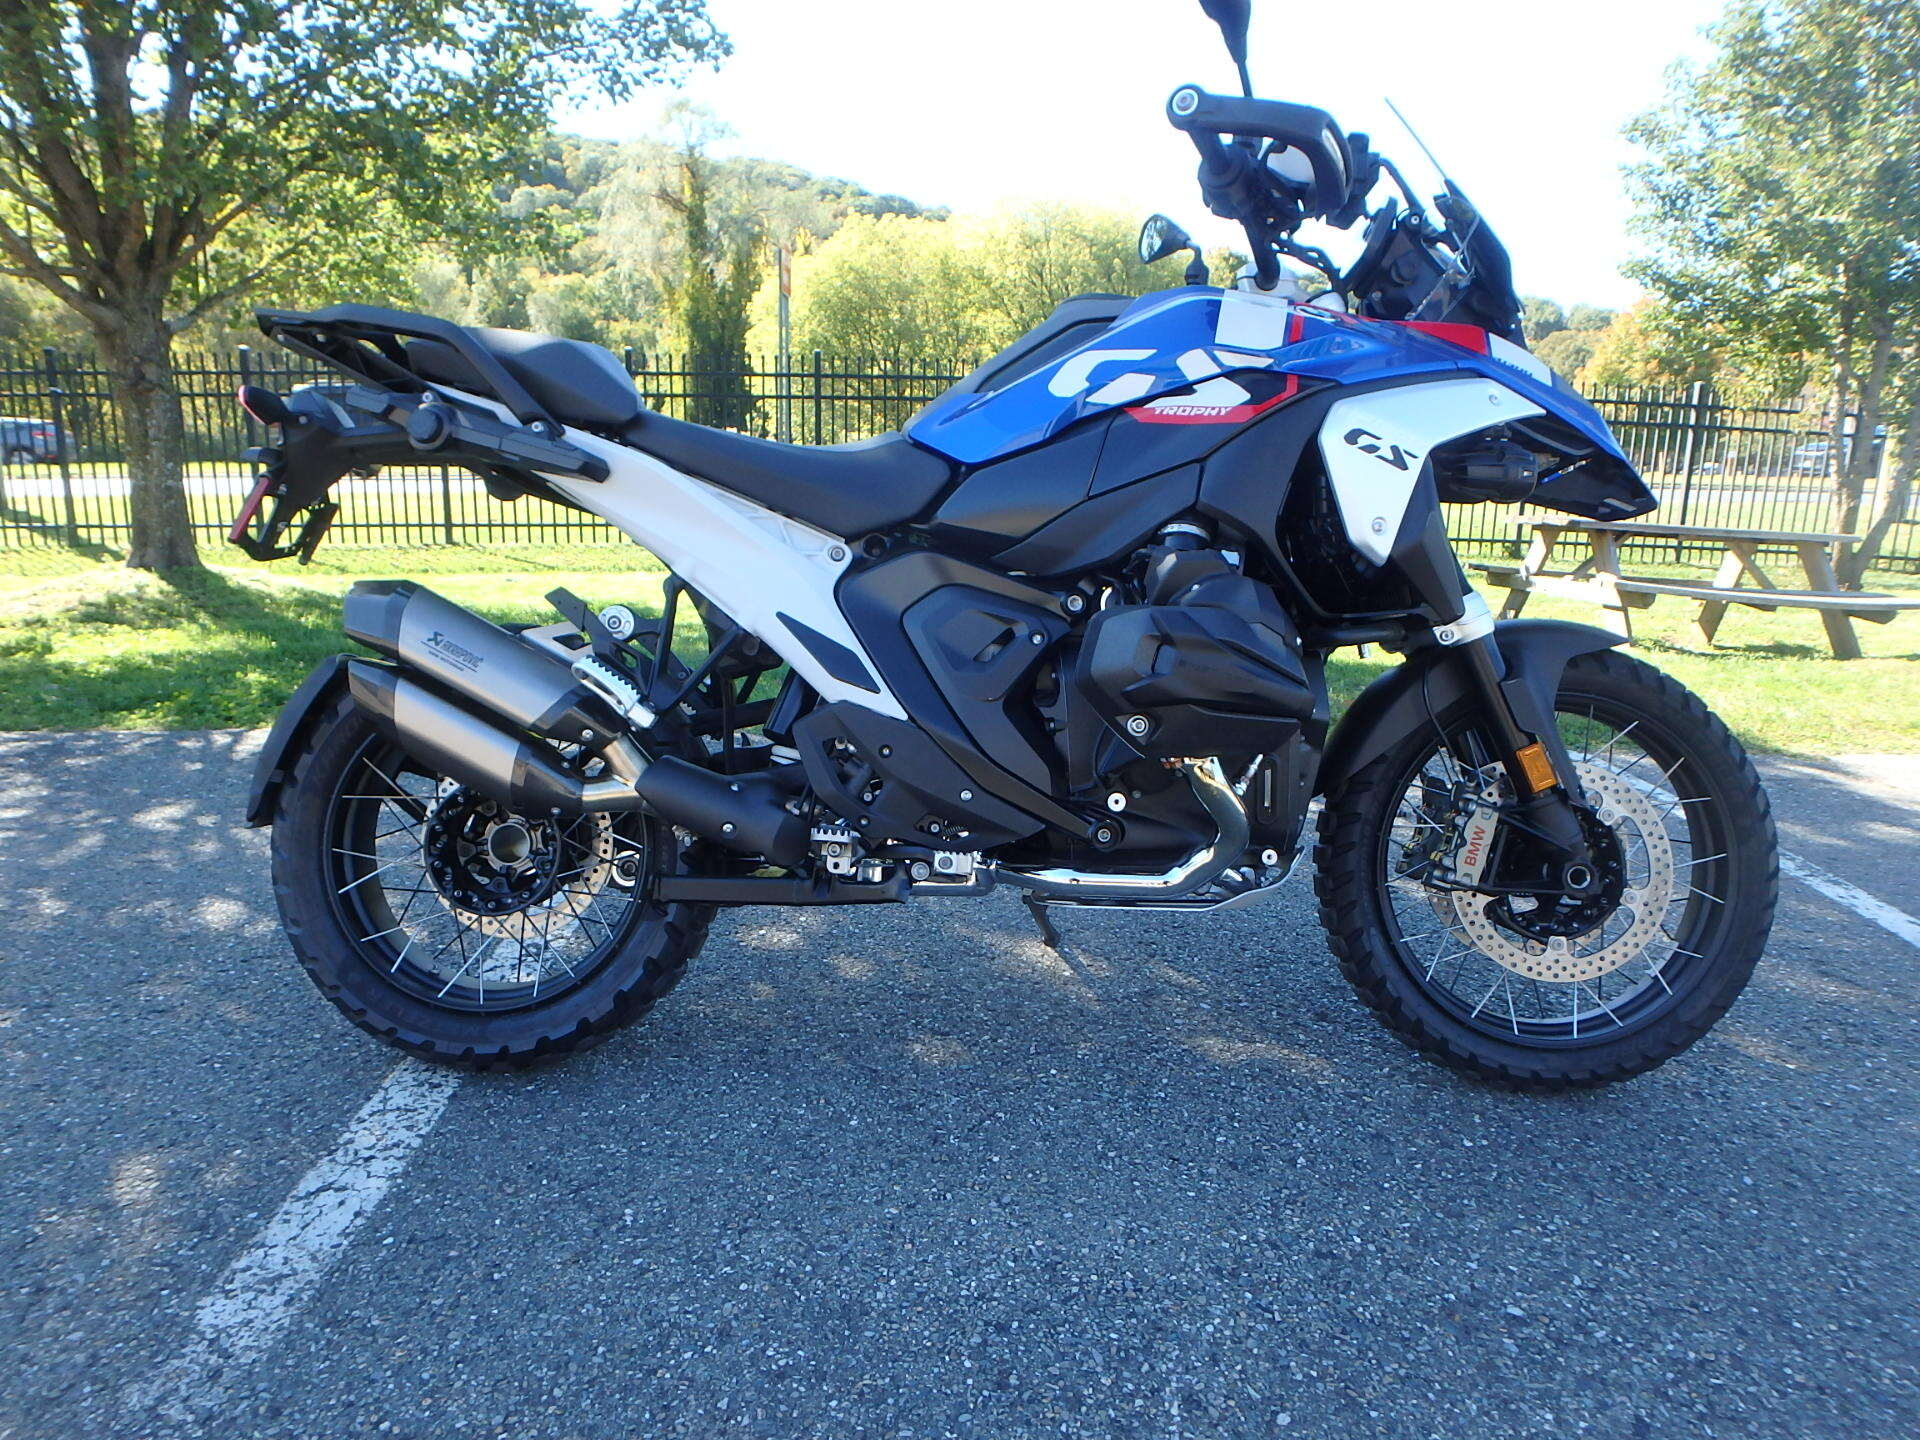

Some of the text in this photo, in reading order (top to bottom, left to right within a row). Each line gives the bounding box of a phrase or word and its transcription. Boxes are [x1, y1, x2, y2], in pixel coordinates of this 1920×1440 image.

[1154, 406, 1233, 416] TROPHY
[1343, 427, 1419, 471] GS
[1464, 825, 1487, 867] BMW
